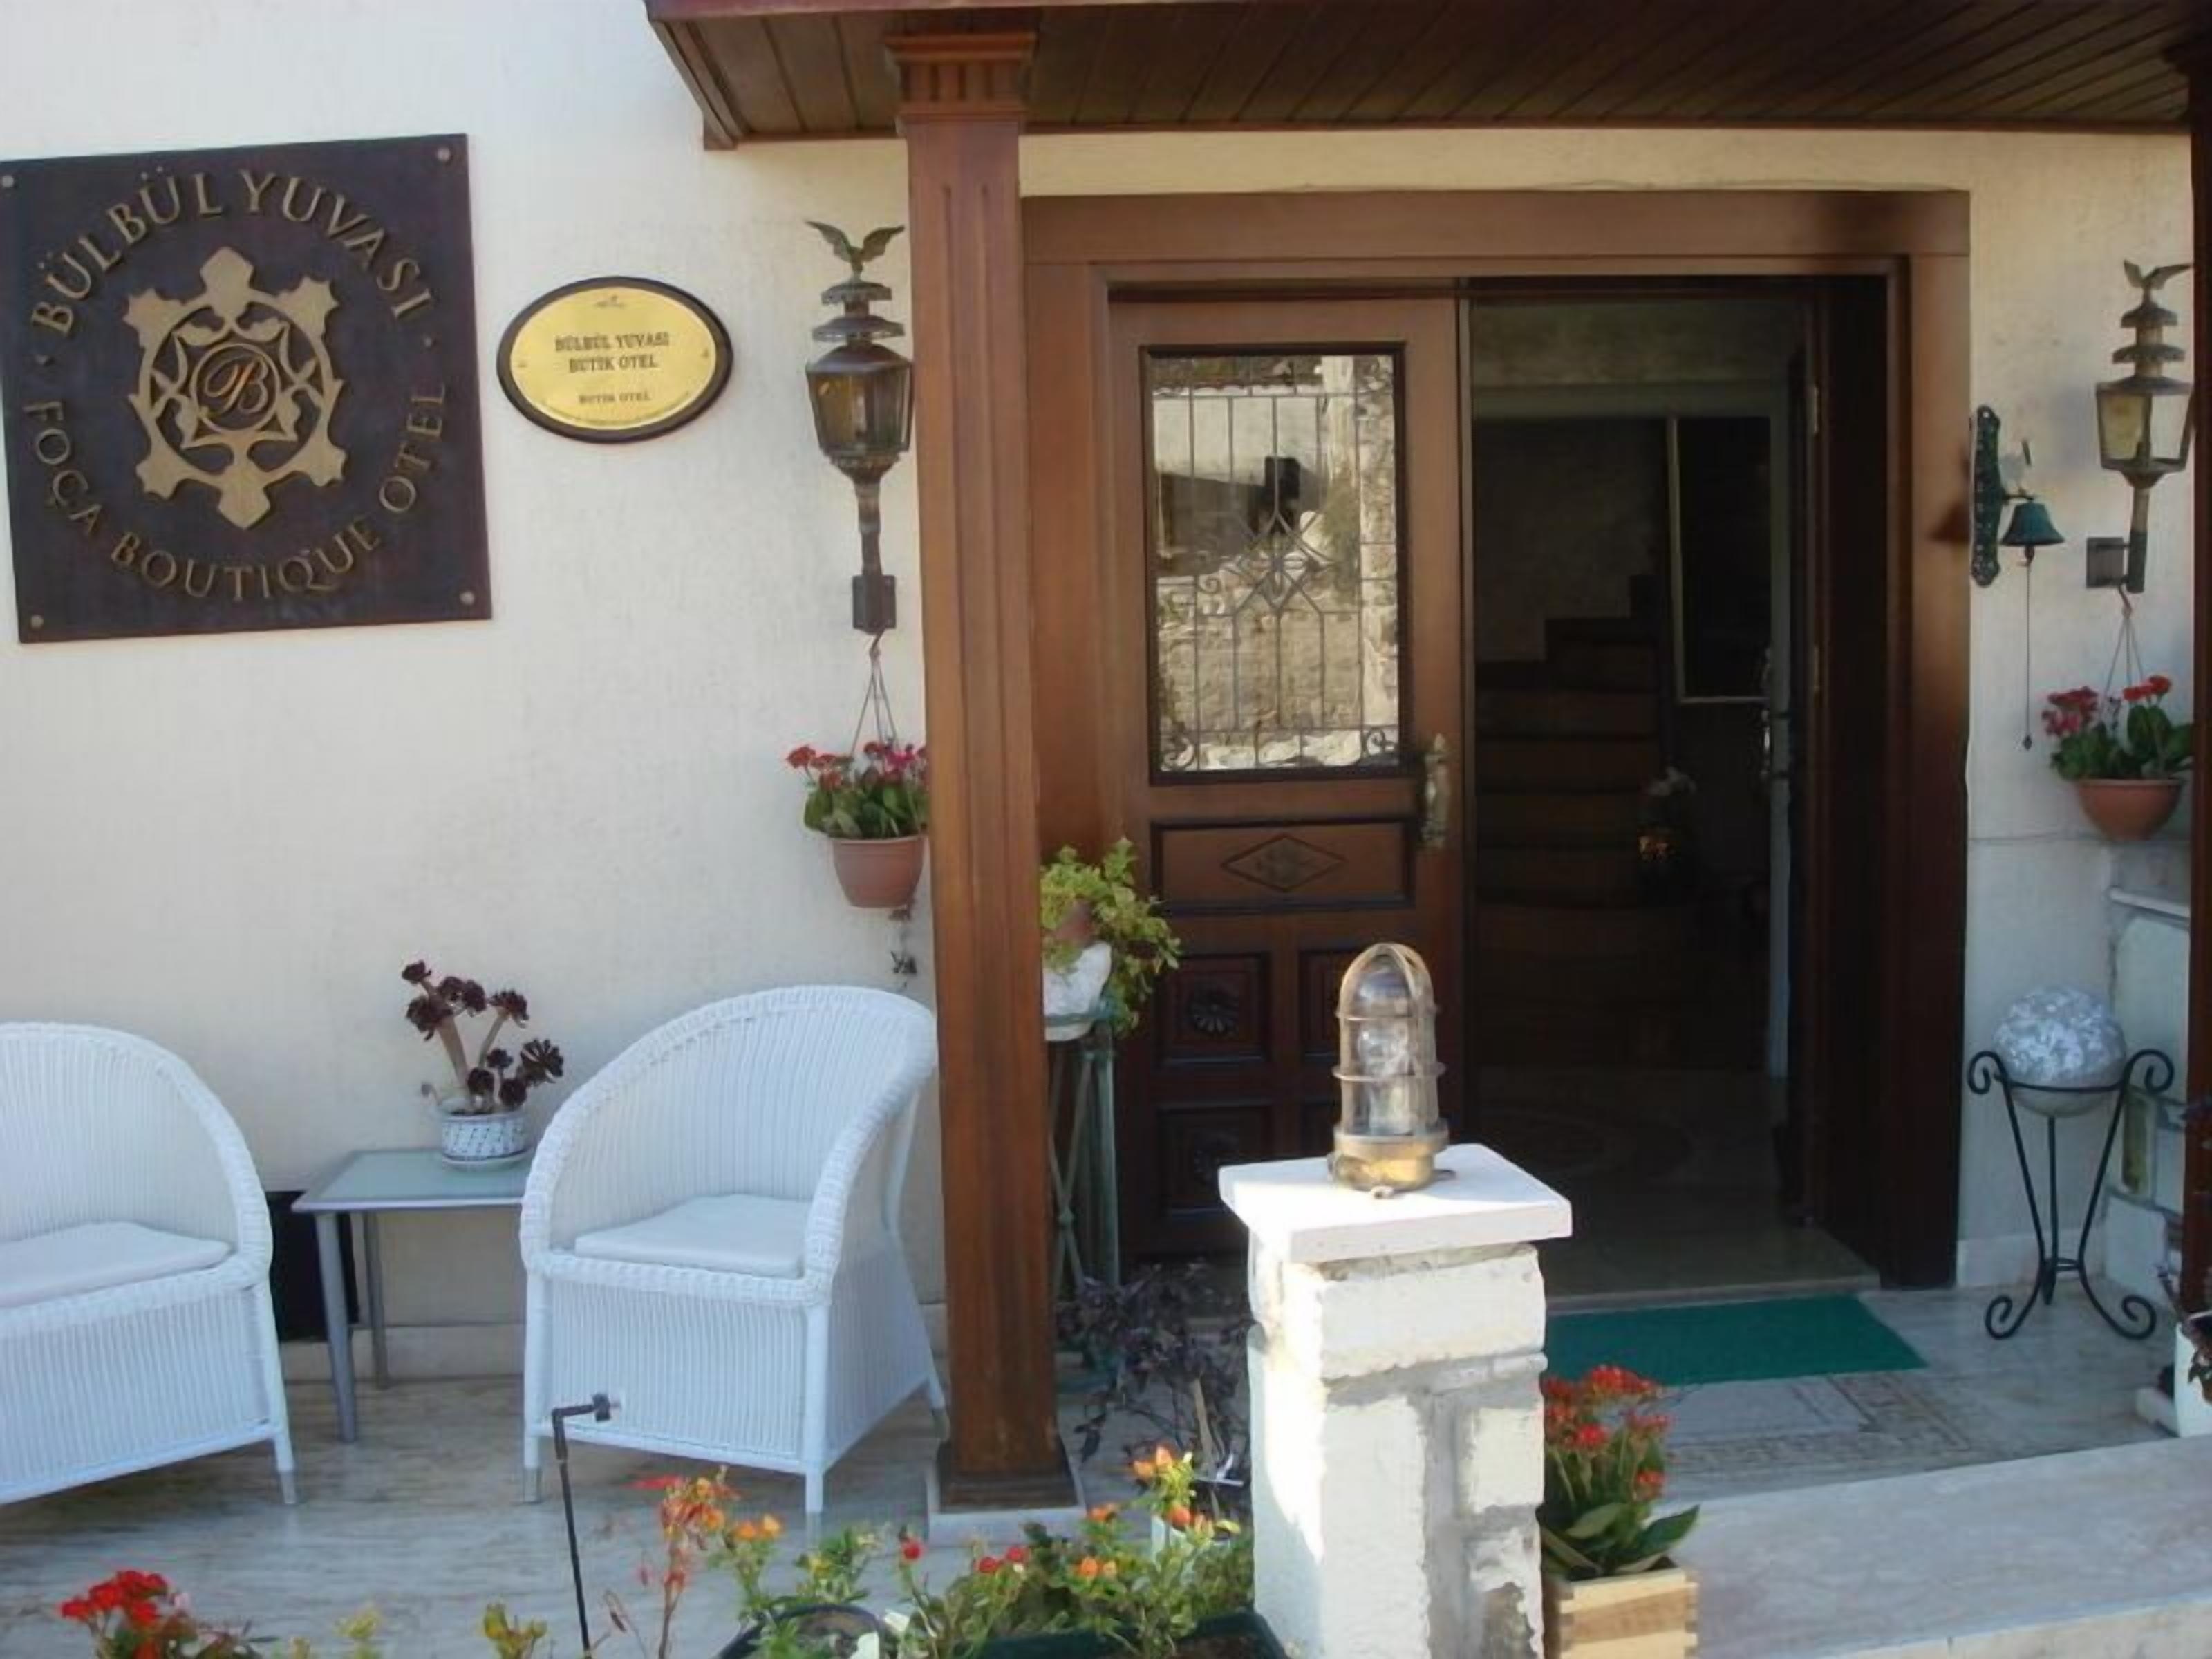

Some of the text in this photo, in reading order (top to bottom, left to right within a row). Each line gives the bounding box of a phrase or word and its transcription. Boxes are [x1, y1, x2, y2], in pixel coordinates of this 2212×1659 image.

[32, 166, 434, 336] BÜLBÜL YUVASI
[619, 354, 658, 370] OTEL
[24, 383, 446, 601] FOÇA BOUTIQUE OTEL
